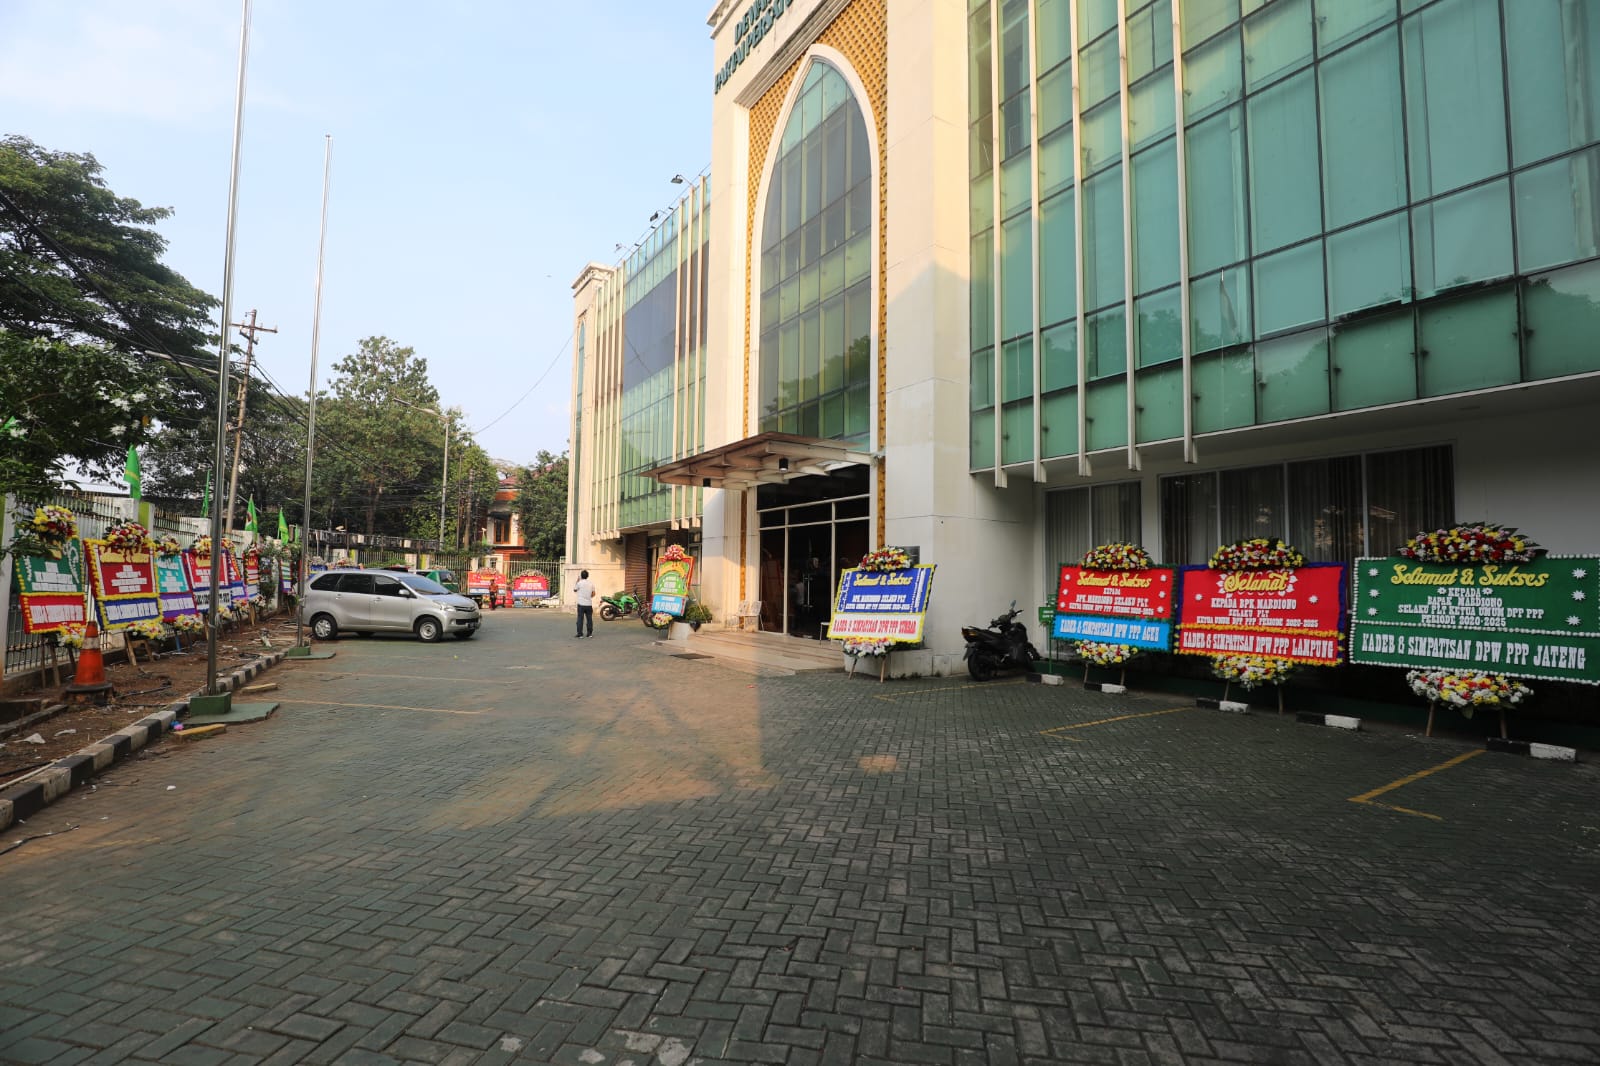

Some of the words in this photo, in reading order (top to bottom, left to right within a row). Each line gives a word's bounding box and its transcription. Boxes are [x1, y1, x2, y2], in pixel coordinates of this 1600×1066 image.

[1224, 570, 1289, 592] Selamat
[1391, 563, 1458, 585] Selamat
[1479, 564, 1549, 587] Sukses
[1448, 587, 1481, 598] KEPADA
[1211, 598, 1237, 608] KEPADA
[1257, 598, 1297, 610] MARDIONO
[1427, 596, 1452, 606] BAPAK
[1457, 597, 1502, 607] MARDIONO
[1398, 604, 1429, 614] SELAKU
[1431, 605, 1447, 614] PLT
[1448, 606, 1476, 616] KETUA
[1479, 607, 1504, 617] UMUM
[1506, 608, 1524, 618] DPP
[1526, 608, 1544, 619] PPP
[1421, 614, 1456, 624] PERIODE
[1212, 633, 1255, 652] SIMPATISAN
[1256, 636, 1273, 653] DPW
[1273, 637, 1290, 655] PPP
[1292, 638, 1334, 658] LAMPUNG
[1407, 636, 1472, 661] SIMPATISAN
[1475, 640, 1502, 663] DPW
[1506, 642, 1530, 666] PPP
[1533, 645, 1586, 670] JATENG
